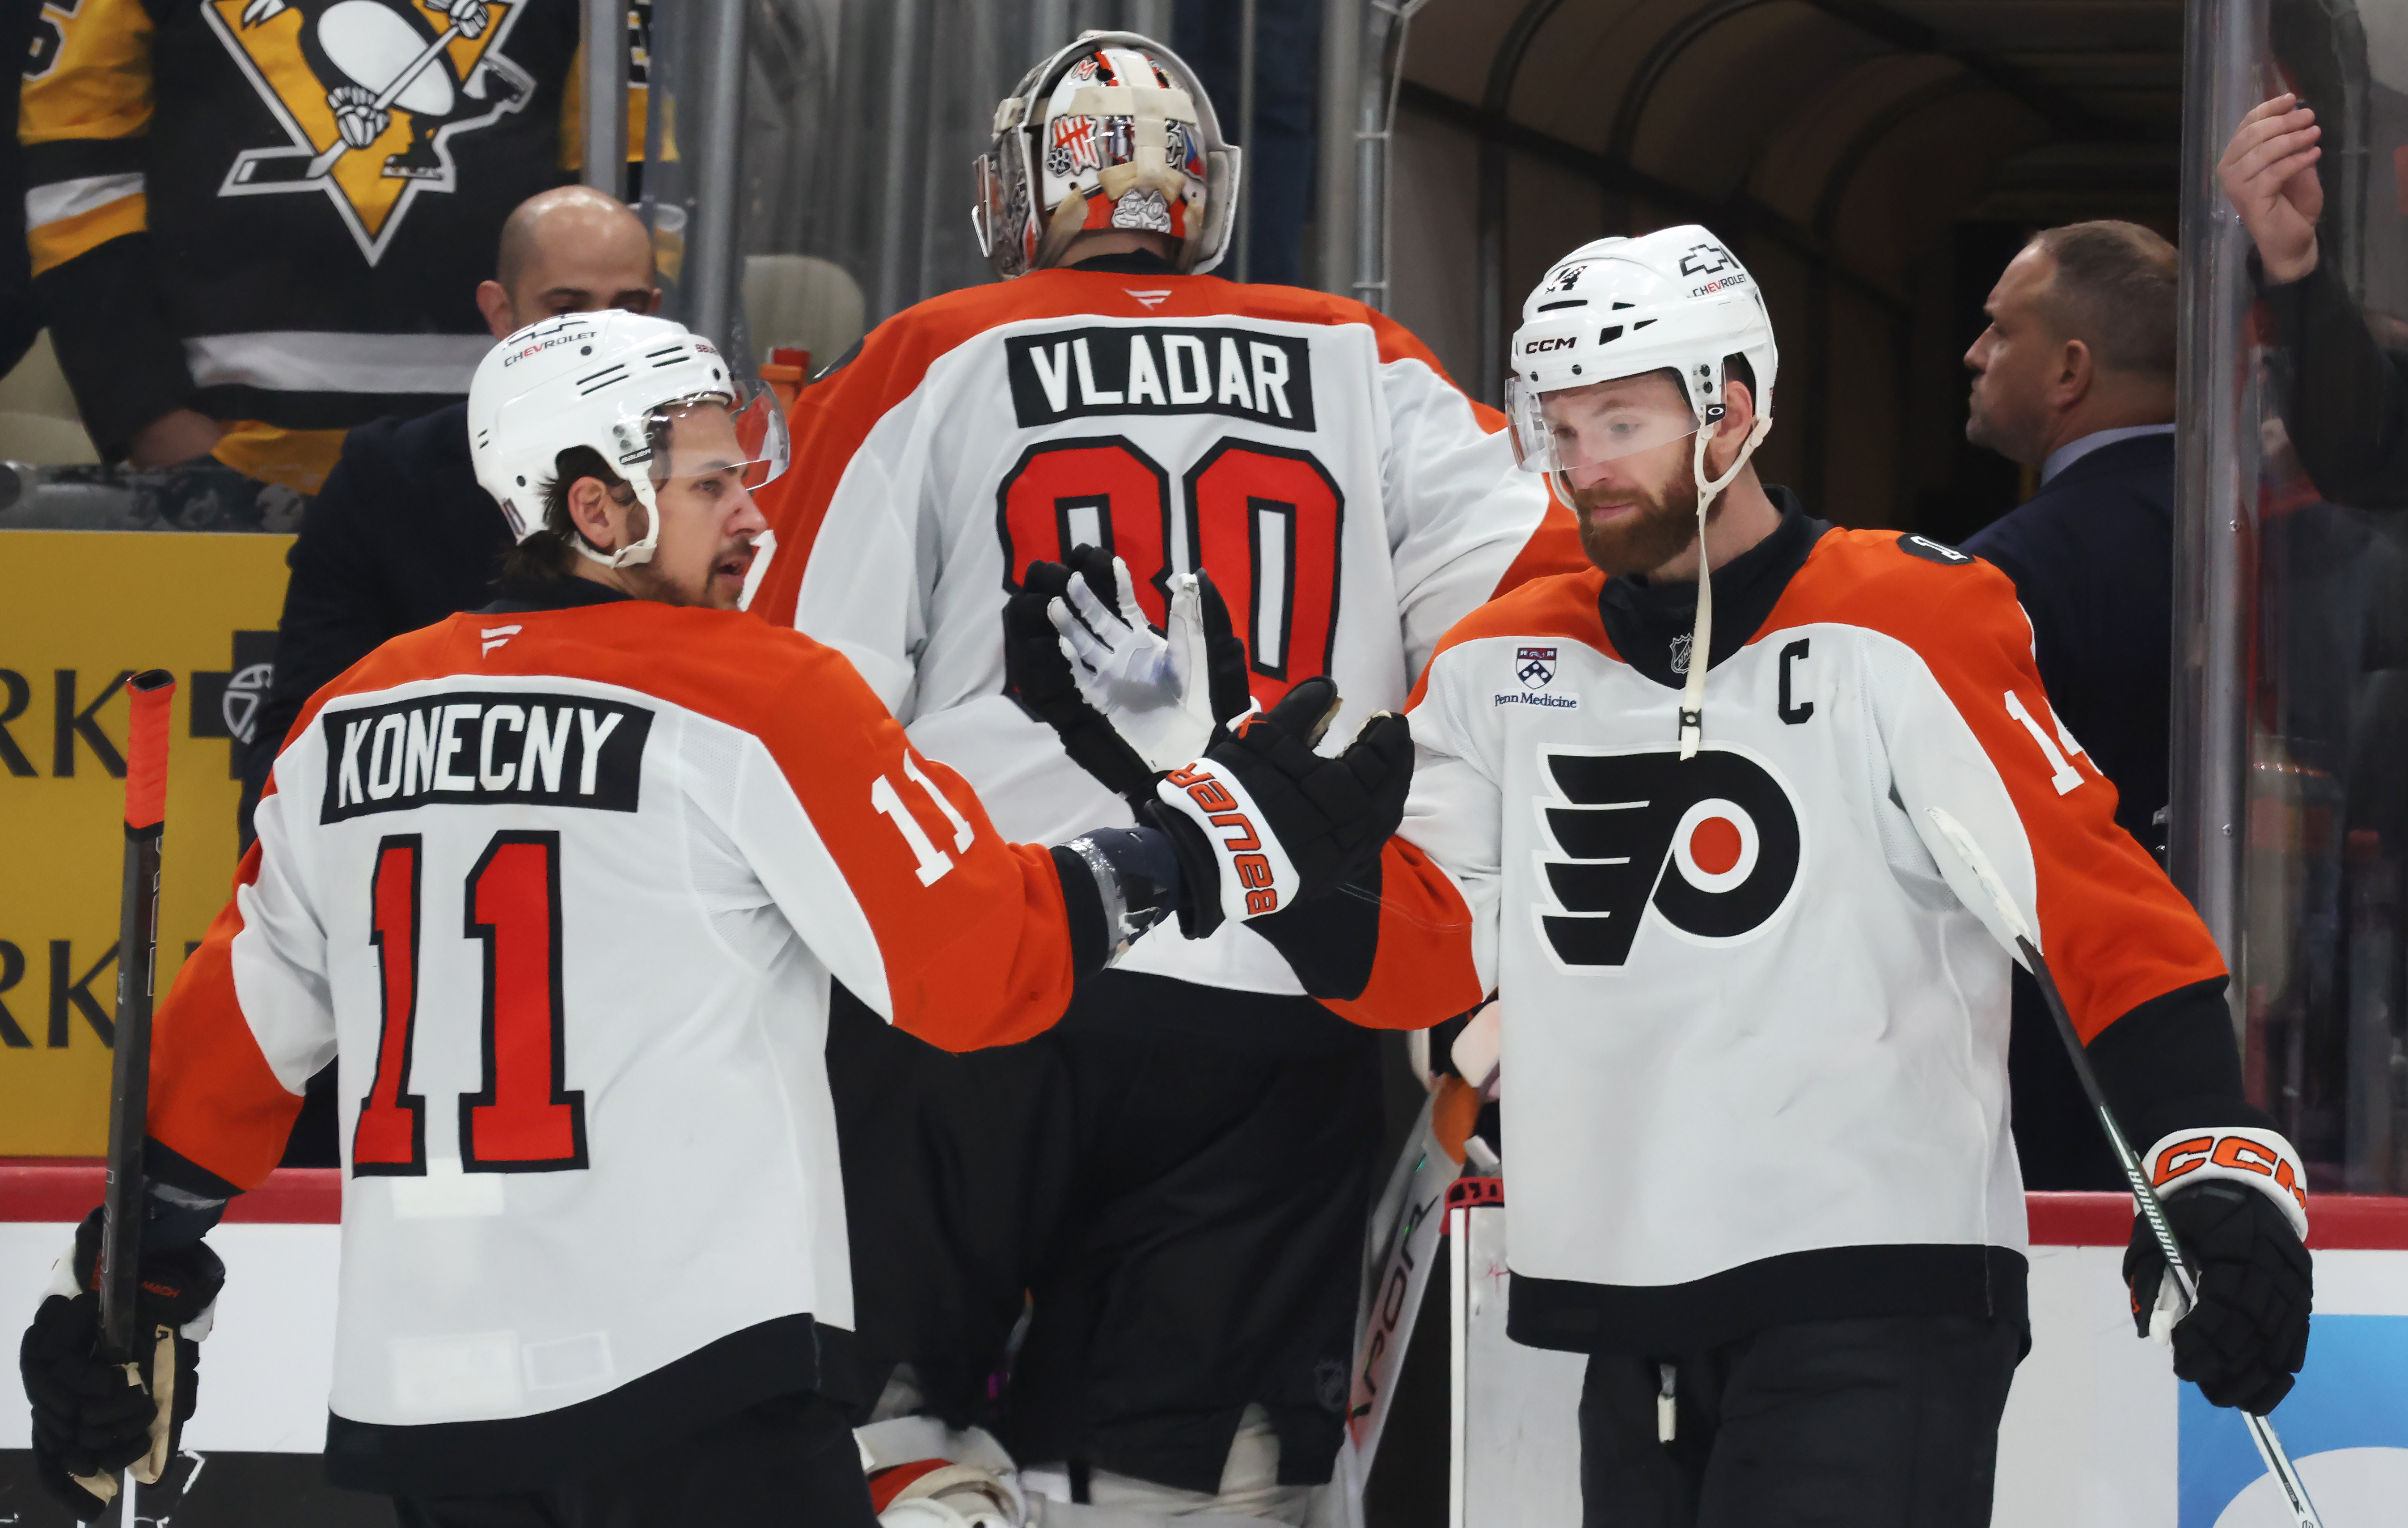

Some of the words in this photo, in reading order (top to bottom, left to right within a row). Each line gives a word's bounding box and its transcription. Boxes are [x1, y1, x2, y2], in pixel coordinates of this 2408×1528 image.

[1692, 274, 1747, 297] CHEVROLET
[504, 331, 597, 367] CHEVROLET
[1029, 334, 1293, 419] VLADAR
[1525, 337, 1577, 355] CCM
[1495, 694, 1518, 707] Penn
[1521, 692, 1577, 708] Medicine
[1778, 638, 1814, 725] C
[337, 703, 624, 808] KONECNY
[871, 748, 975, 888] 11
[352, 830, 589, 1180] 11
[2150, 1136, 2306, 1210] CCM
[2128, 1171, 2183, 1264] WARRIOR
